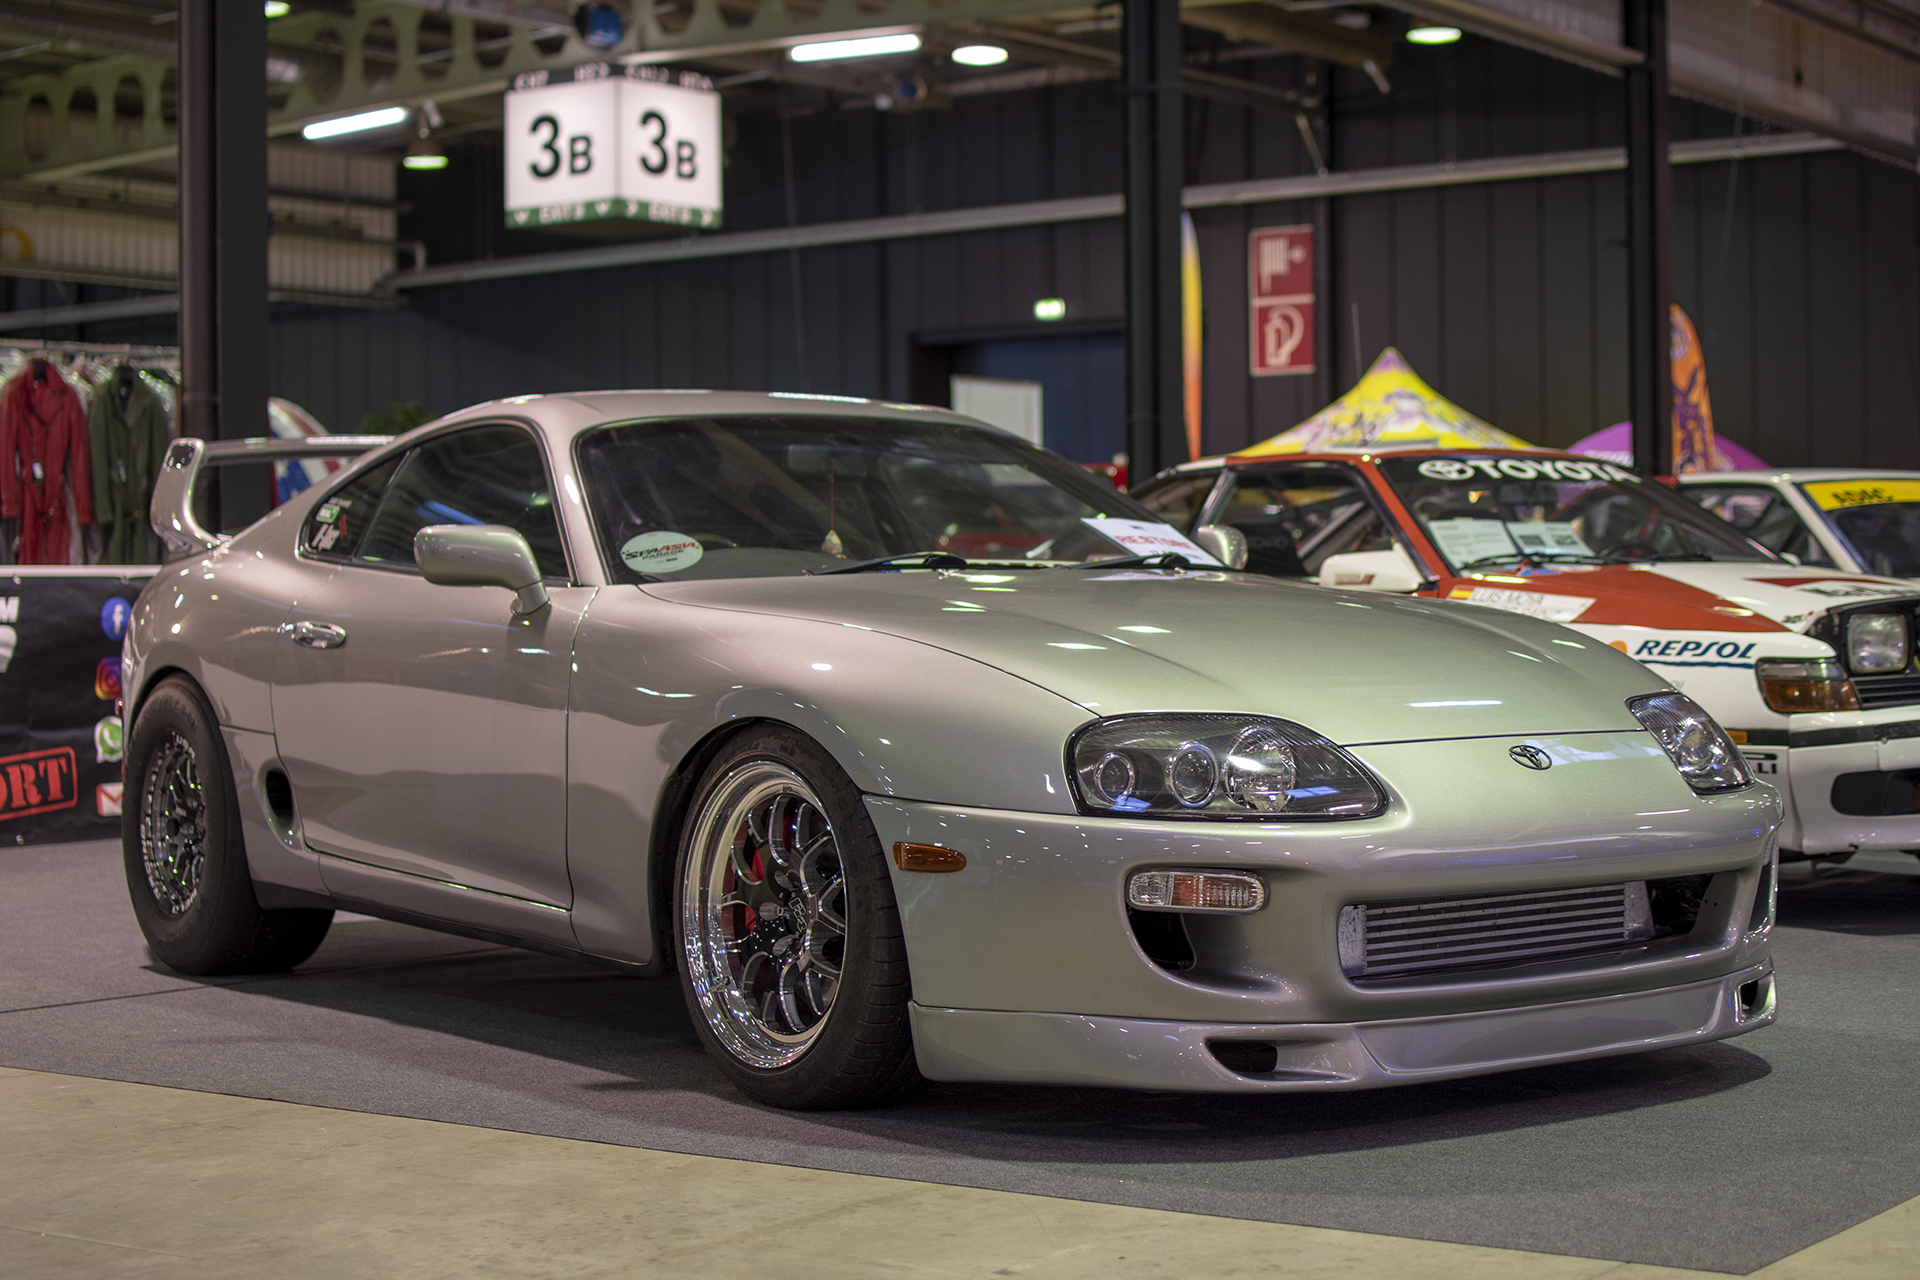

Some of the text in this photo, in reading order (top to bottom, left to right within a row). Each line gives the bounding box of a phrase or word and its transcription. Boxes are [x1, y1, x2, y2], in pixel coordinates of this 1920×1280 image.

[530, 115, 592, 178] 3 B
[641, 111, 696, 179] 3 B
[1466, 459, 1643, 483] TOYOTA
[642, 549, 684, 560] PARADE
[1471, 587, 1545, 606] LUIS MOYA
[1635, 640, 1757, 658] REPSOL
